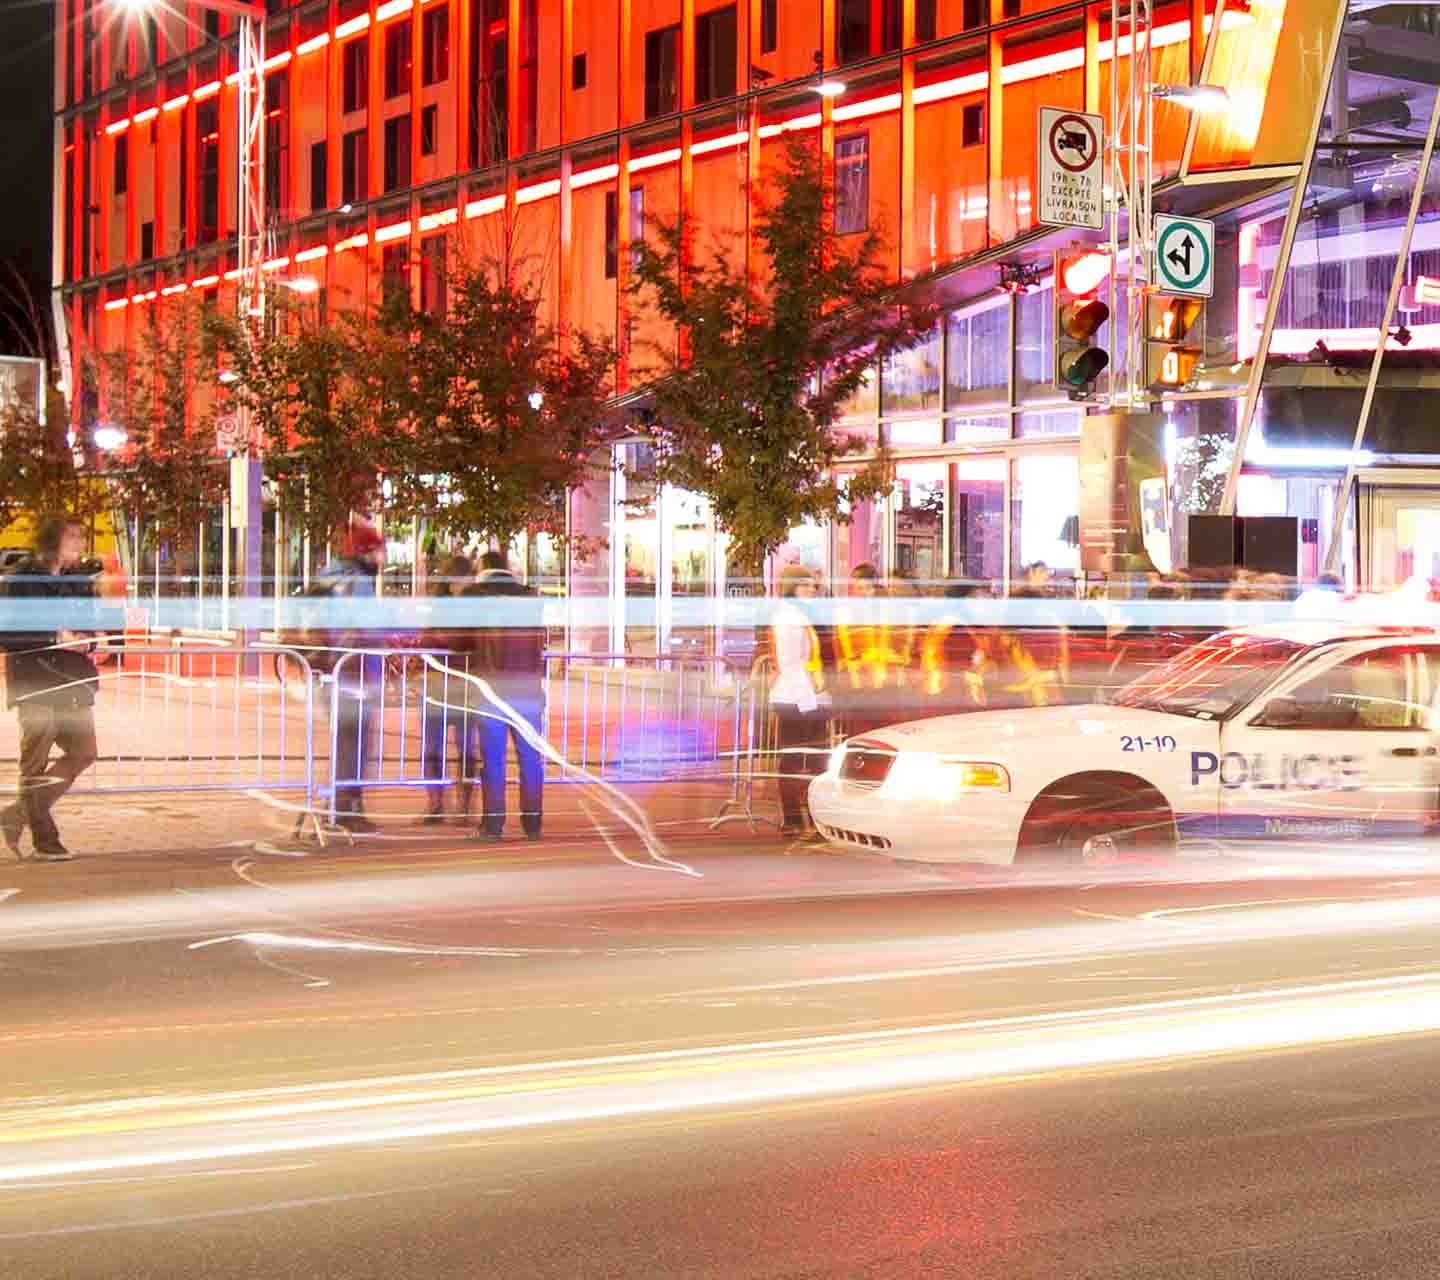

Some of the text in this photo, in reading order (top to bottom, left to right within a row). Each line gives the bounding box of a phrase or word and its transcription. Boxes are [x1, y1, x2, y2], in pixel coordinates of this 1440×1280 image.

[1046, 197, 1097, 214] LIVRAISON
[1053, 210, 1090, 224] LOCALE
[1190, 751, 1368, 790] POLICE
